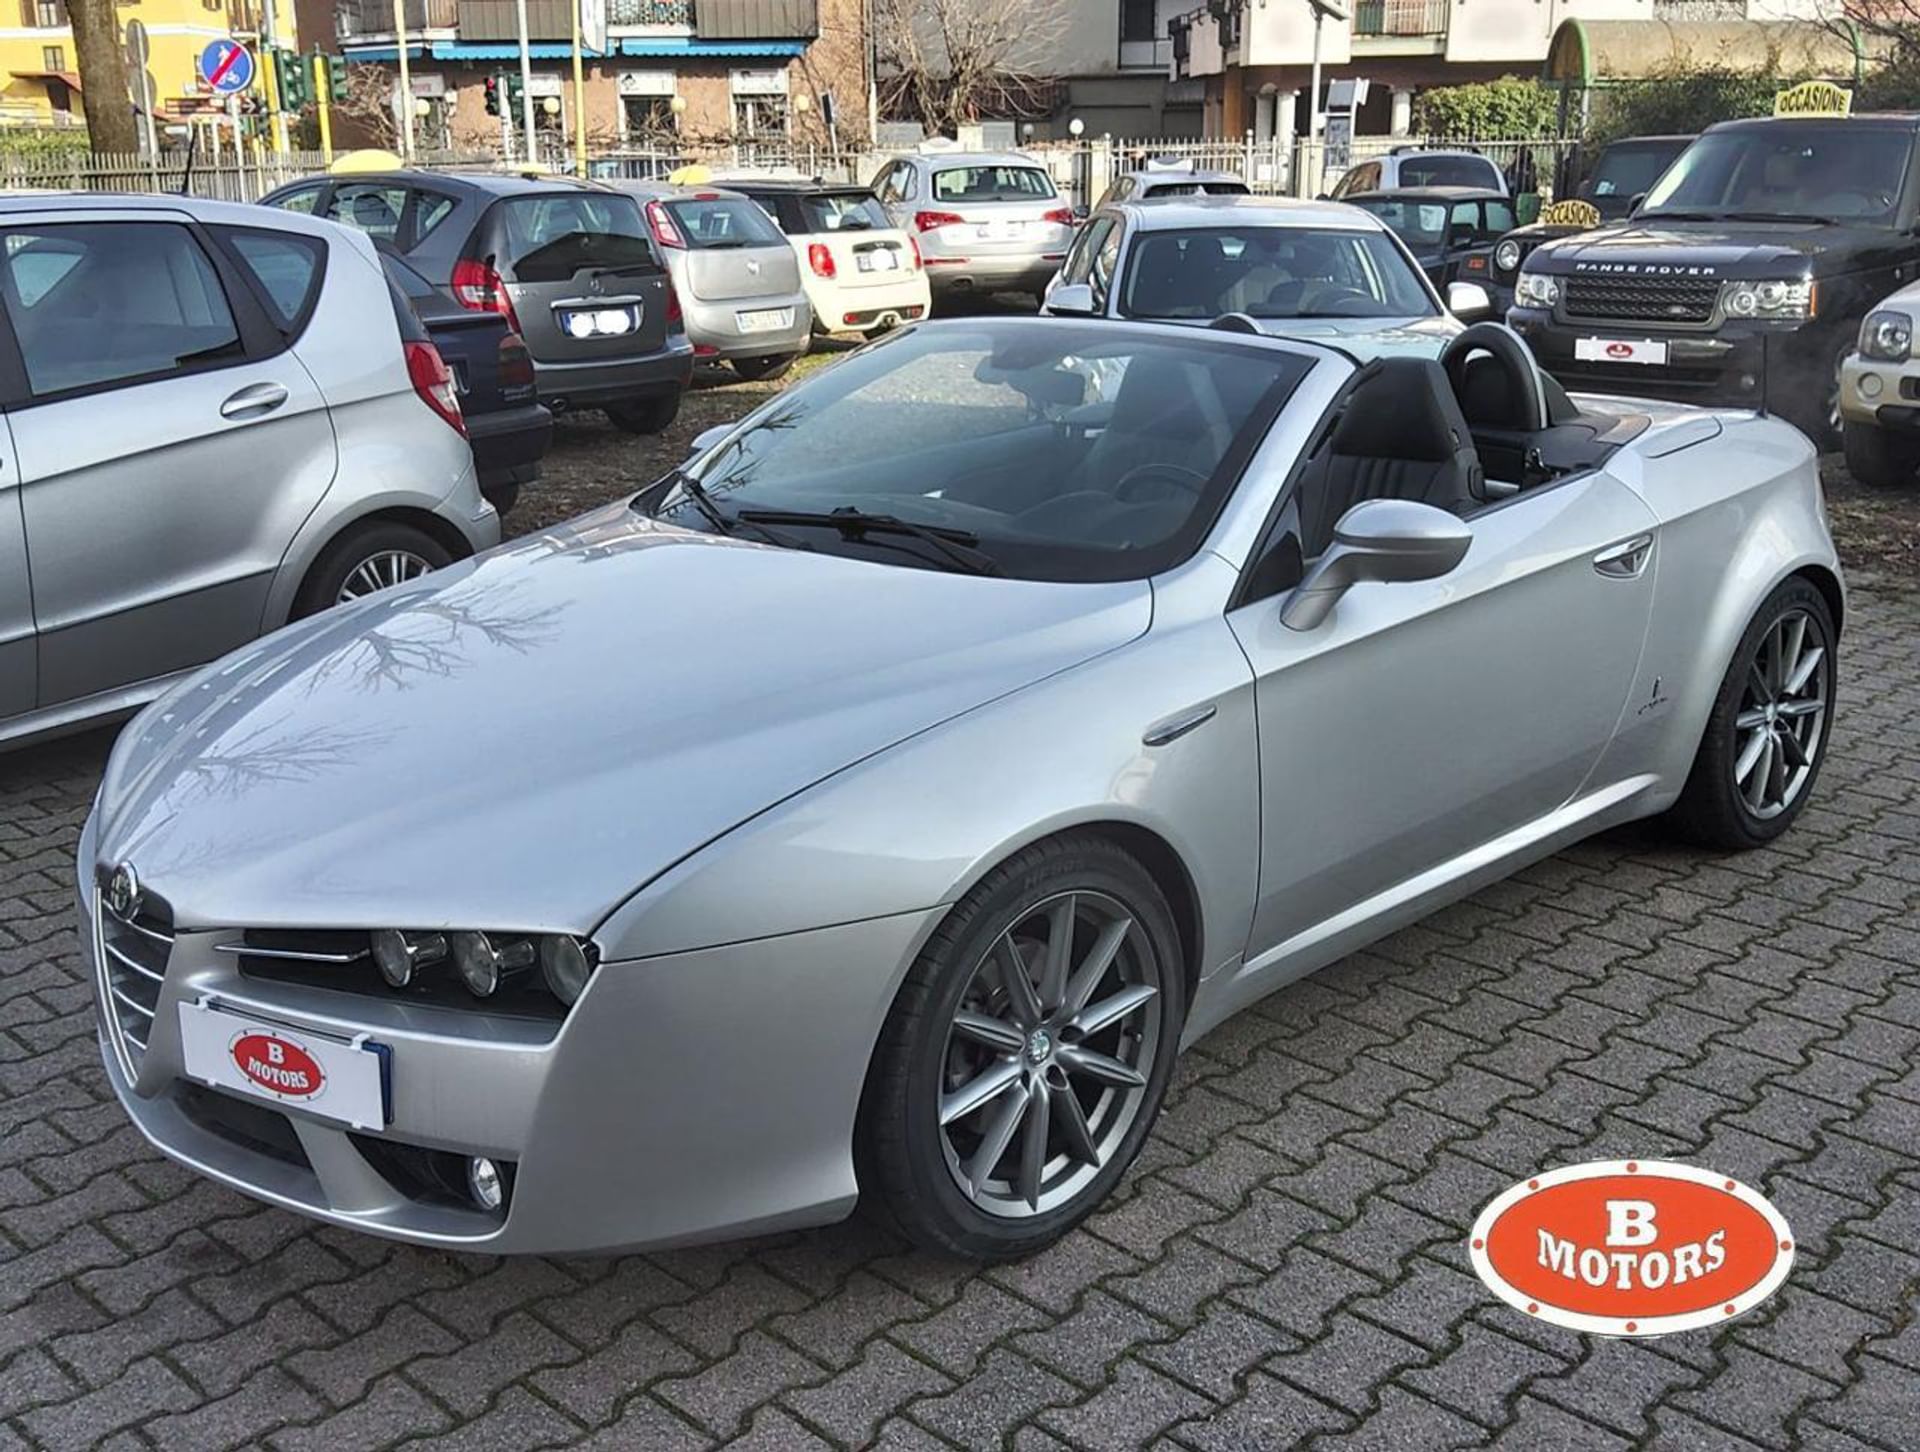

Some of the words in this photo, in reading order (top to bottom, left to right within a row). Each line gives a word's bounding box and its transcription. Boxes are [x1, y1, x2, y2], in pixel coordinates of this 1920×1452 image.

[1779, 86, 1847, 112] OCCASIONE
[1545, 202, 1598, 224] OCCASIONE
[1576, 263, 1639, 273] RANGE
[1645, 266, 1716, 275] ROVER
[267, 1042, 284, 1064] B
[247, 1056, 309, 1089] MOTORS
